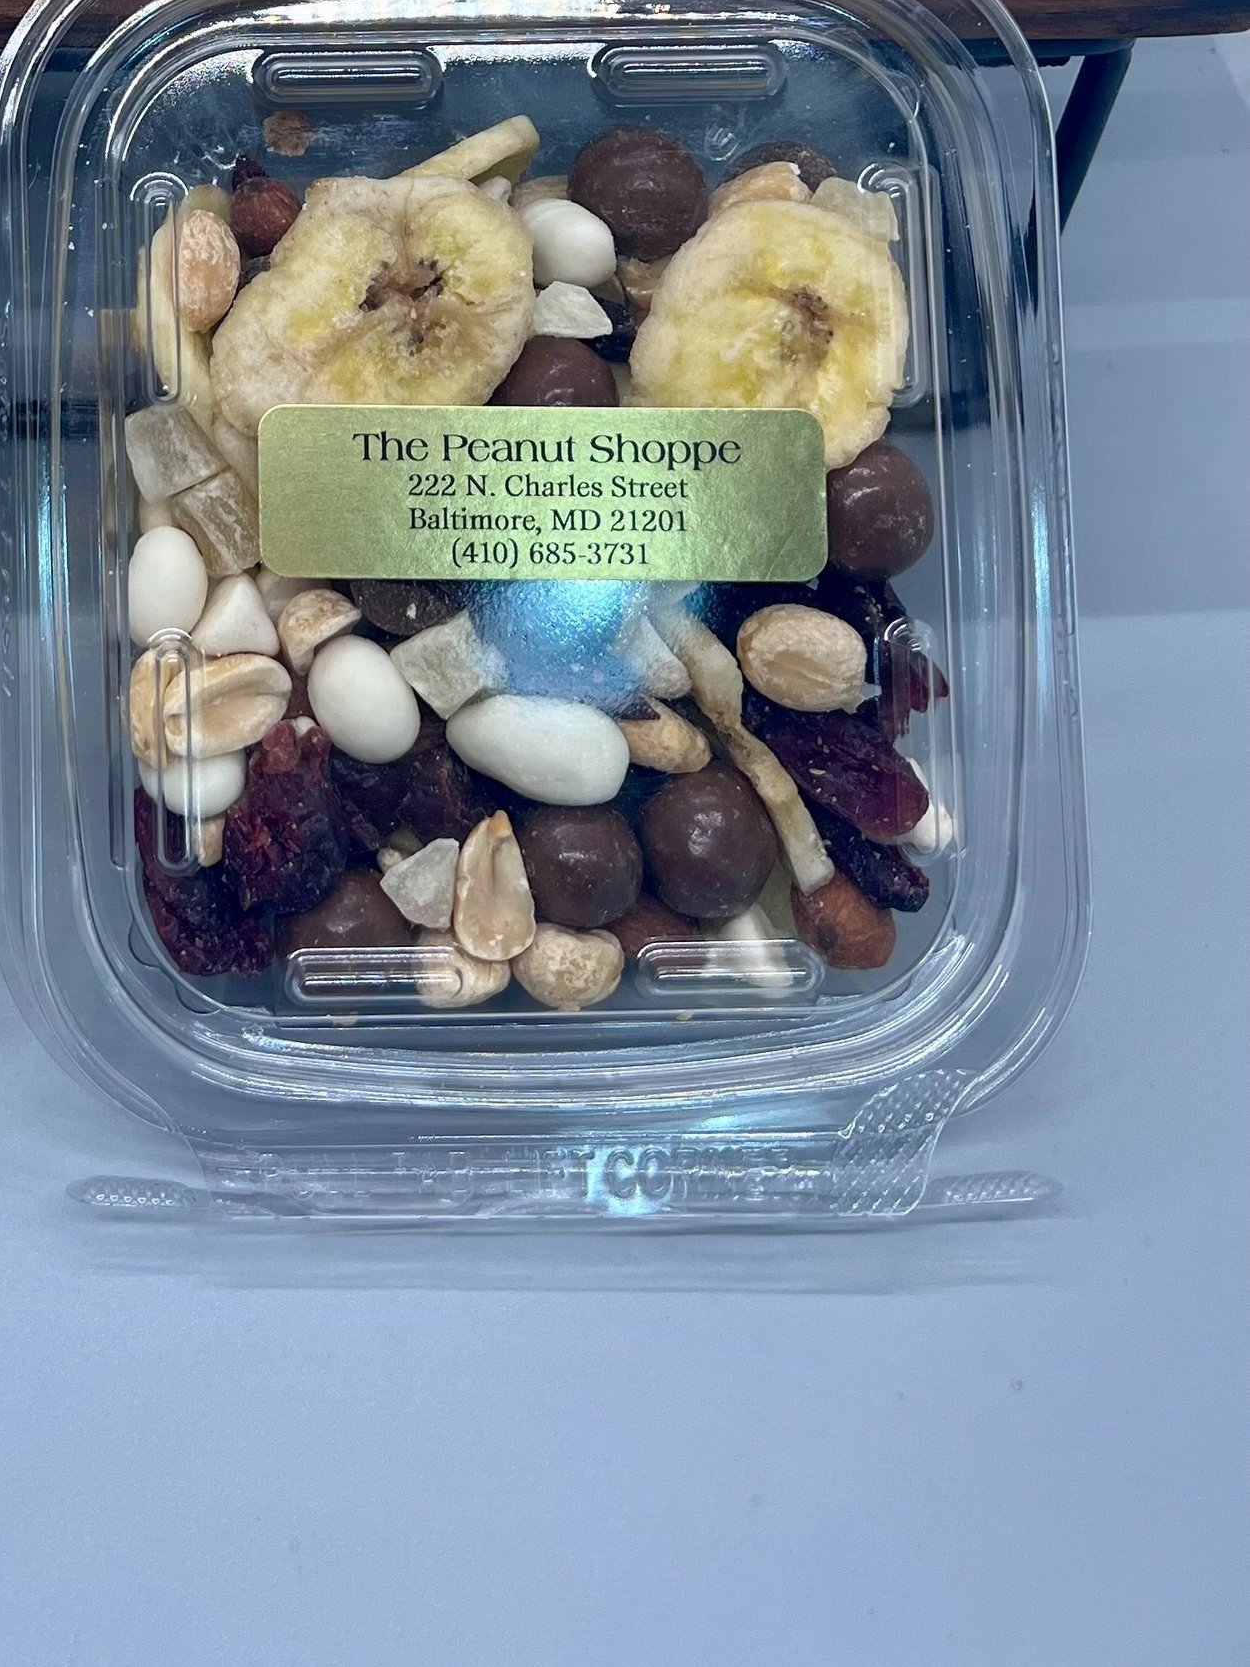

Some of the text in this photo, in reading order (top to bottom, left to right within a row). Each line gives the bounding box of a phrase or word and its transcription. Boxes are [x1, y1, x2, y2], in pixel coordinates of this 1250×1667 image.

[351, 429, 742, 472] The Peanut Shoppe
[408, 472, 689, 500] 222 N. Charles Street
[408, 505, 688, 538] Baltimore, MD 21201
[451, 536, 650, 570] (410) 685-3731
